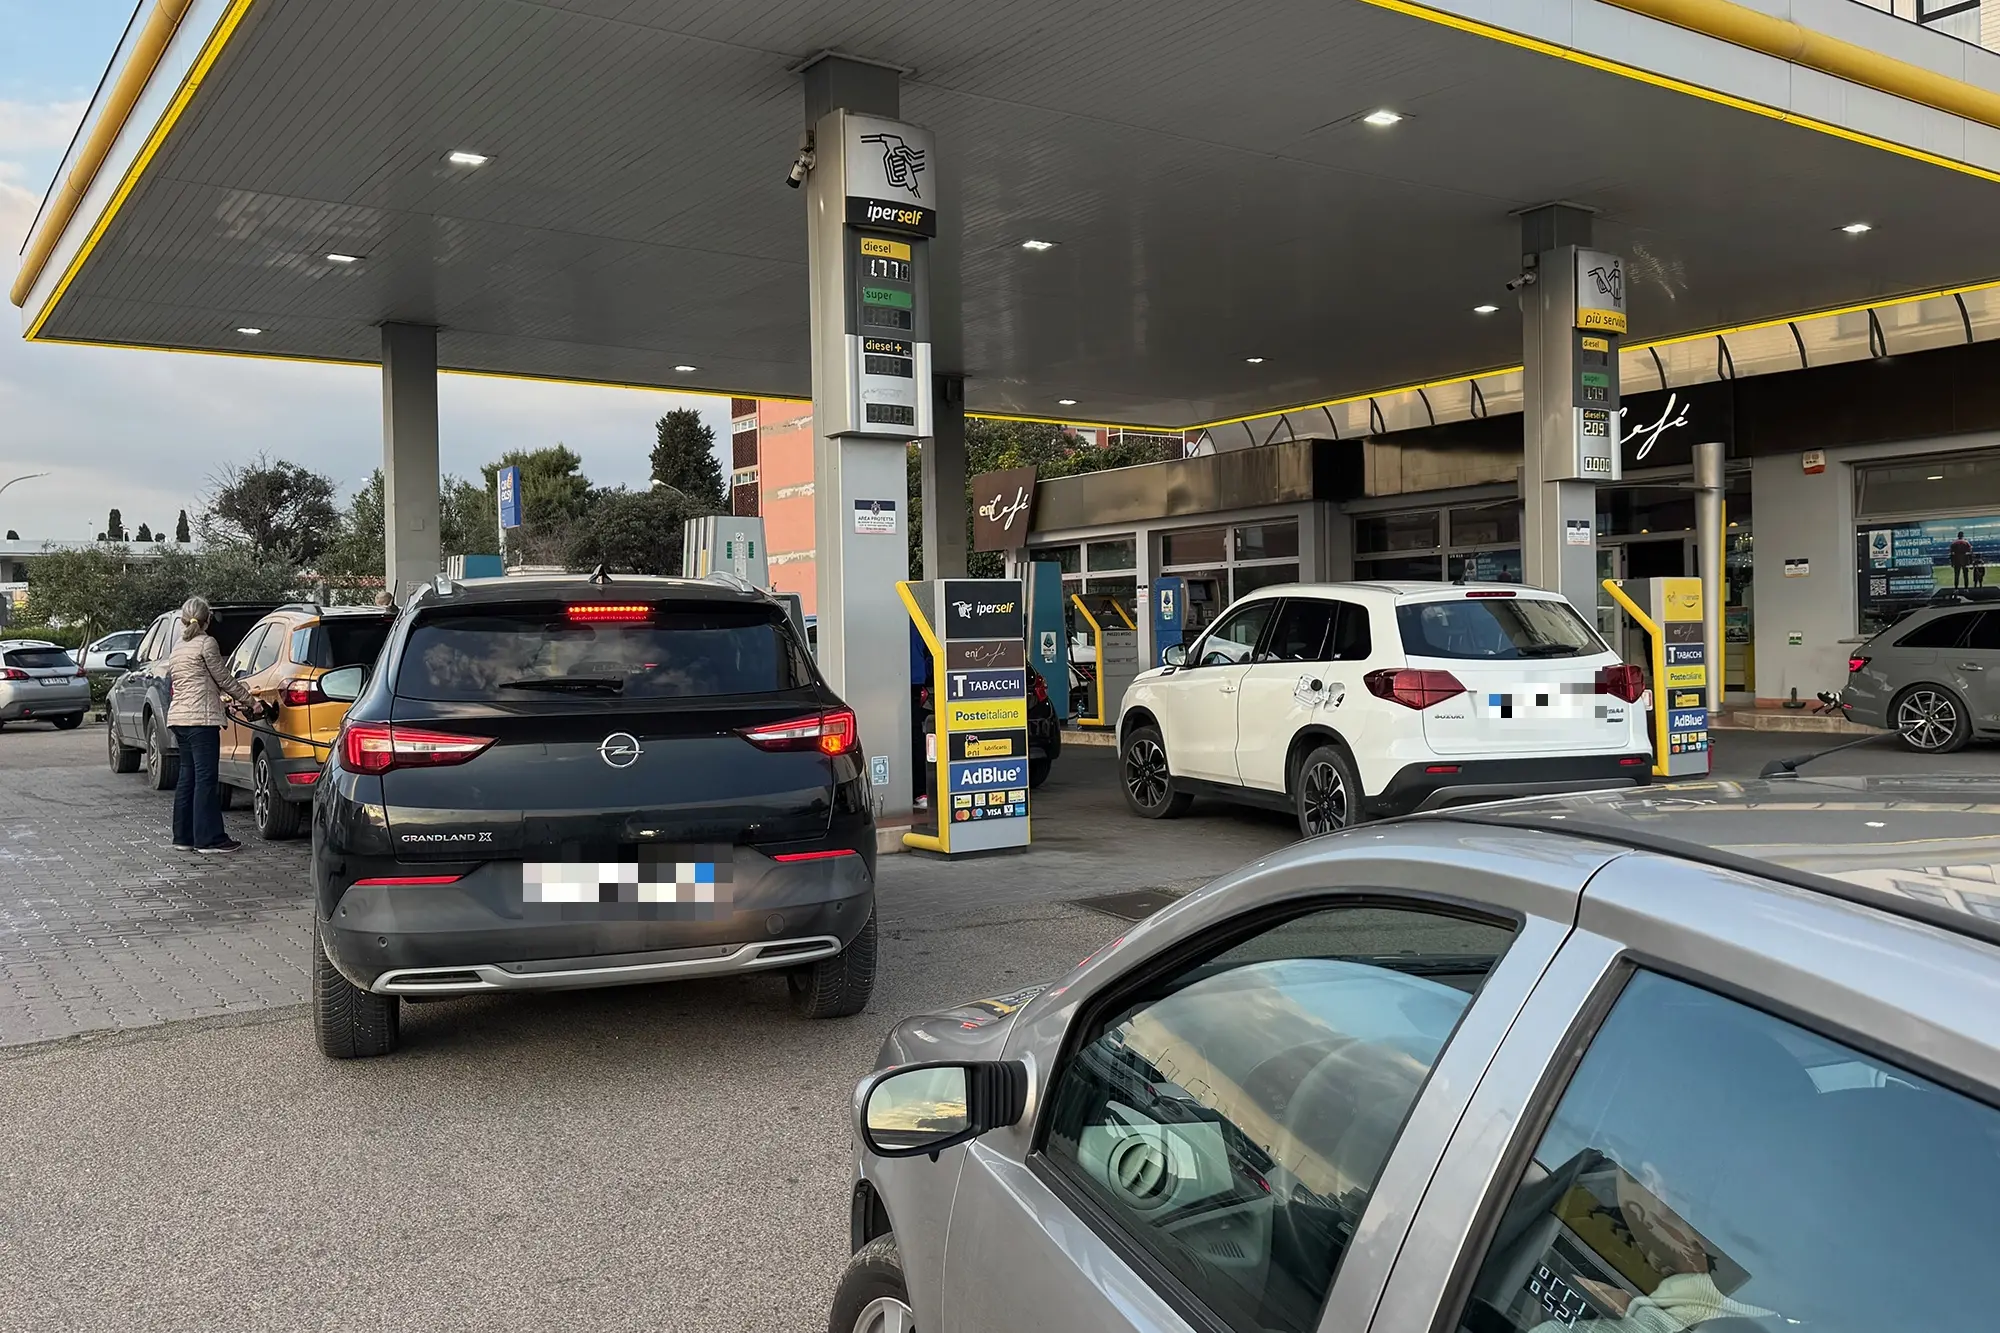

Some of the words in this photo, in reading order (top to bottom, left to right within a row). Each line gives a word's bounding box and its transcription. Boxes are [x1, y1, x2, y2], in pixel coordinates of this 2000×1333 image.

[867, 201, 923, 226] iperself
[864, 241, 891, 253] diesel
[866, 290, 892, 301] super
[1585, 312, 1601, 326] più
[976, 601, 1015, 616] iperself
[1676, 651, 1702, 659] TABACCHI
[969, 680, 1020, 692] TABACCHI
[967, 748, 980, 757] eni
[401, 834, 476, 842] GRANDLAND
[478, 832, 493, 842] X
